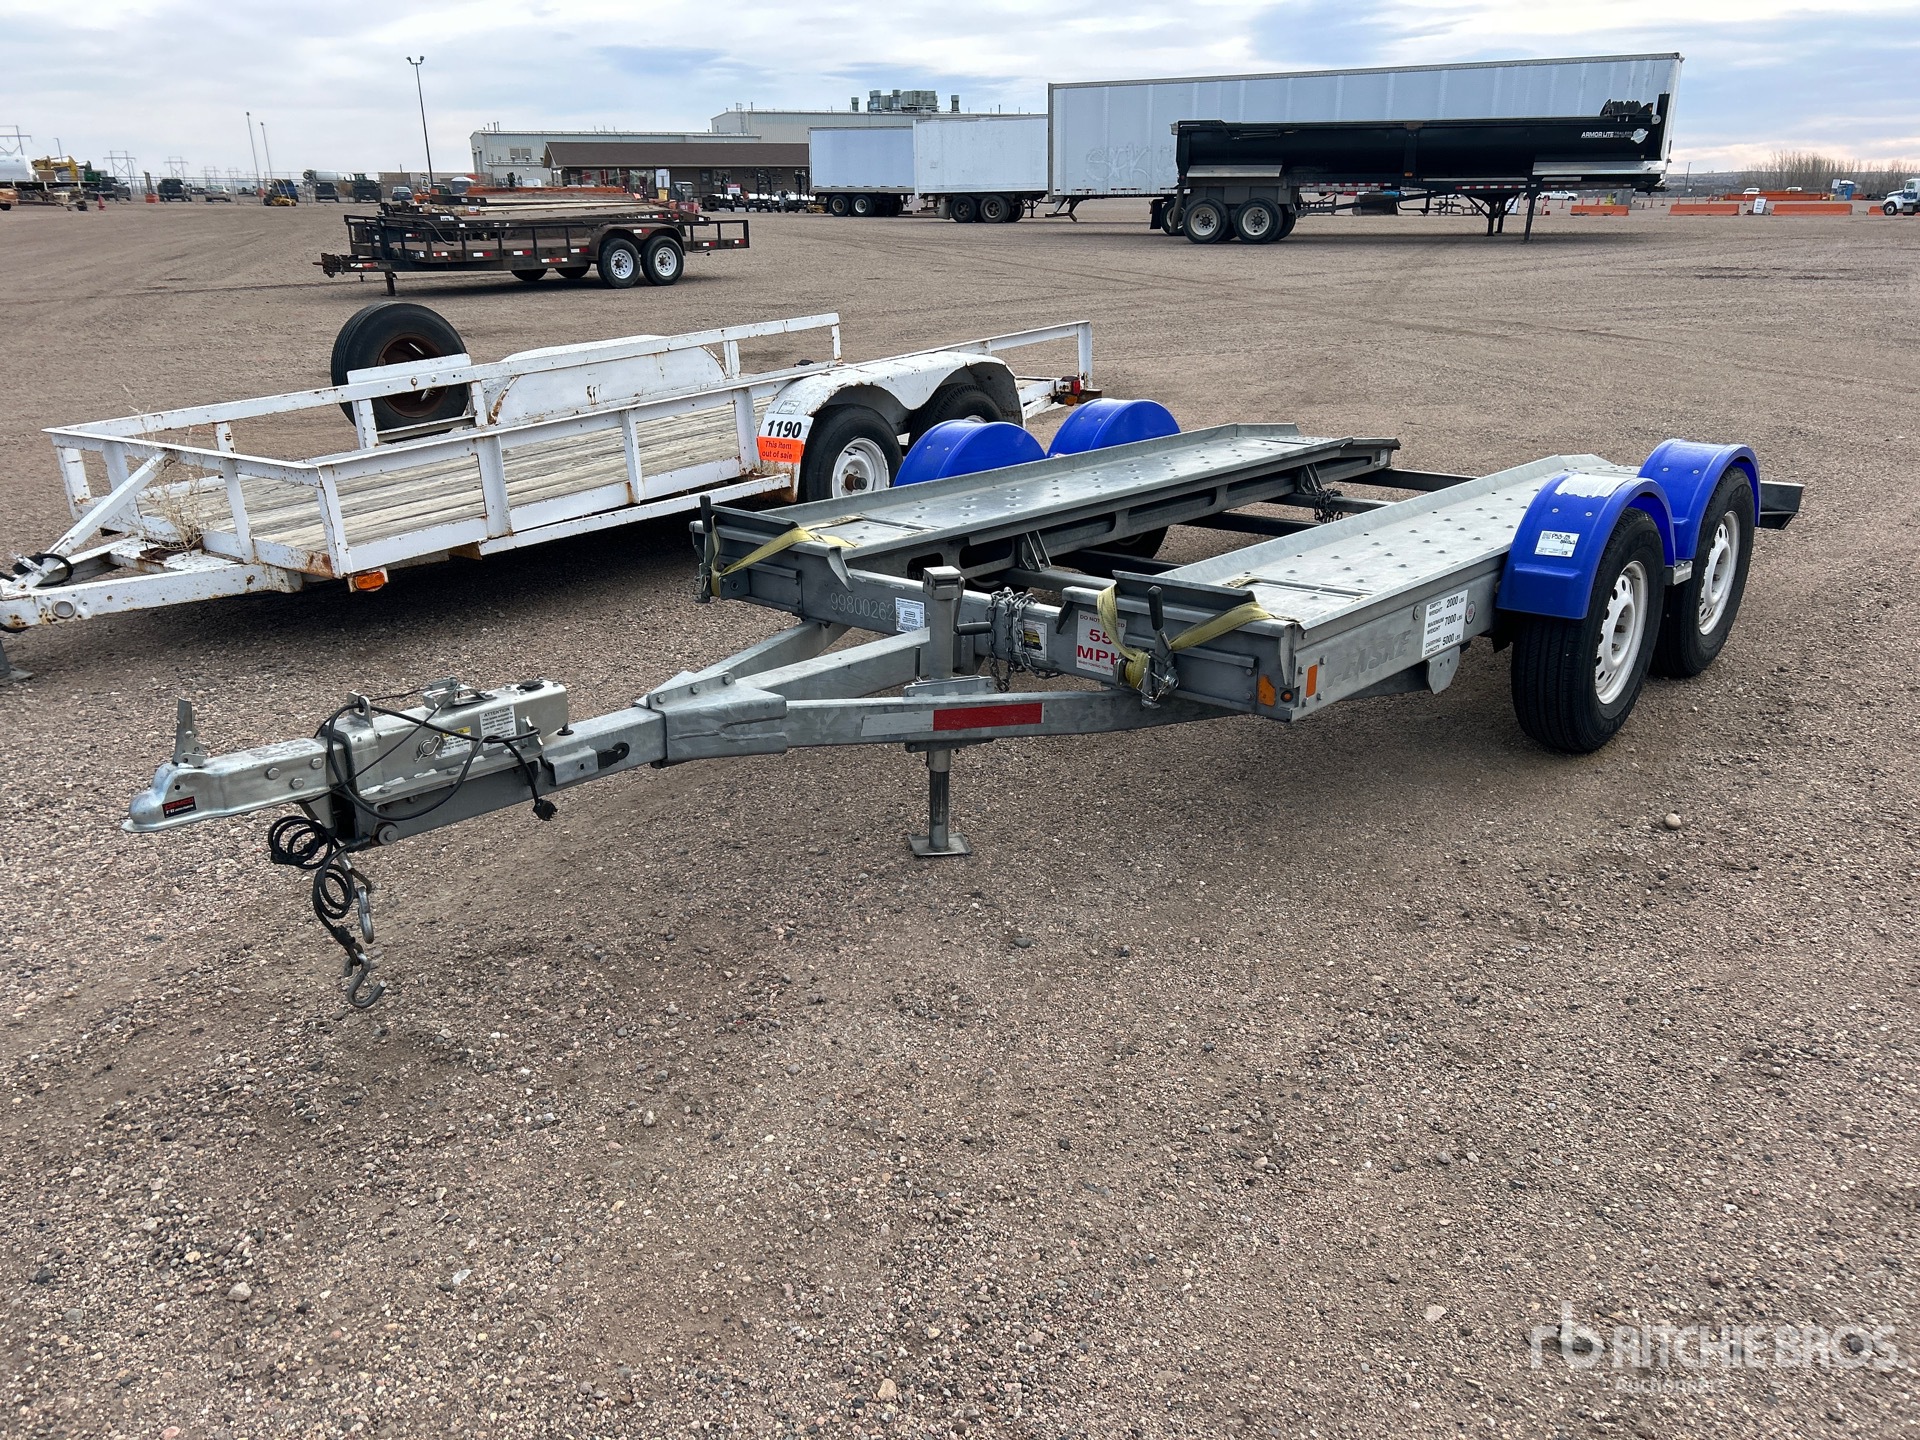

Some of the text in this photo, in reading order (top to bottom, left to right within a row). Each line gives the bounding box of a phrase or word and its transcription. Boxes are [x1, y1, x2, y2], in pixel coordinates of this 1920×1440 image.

[767, 420, 802, 438] 1190
[765, 440, 792, 450] This item
[761, 450, 793, 460] out of sale
[830, 592, 895, 622] 99800262
[1446, 595, 1459, 608] 2000
[1444, 613, 1457, 626] 7000
[1089, 628, 1113, 645] 55
[1442, 633, 1455, 646] 5000
[484, 708, 510, 717] ATTENTION
